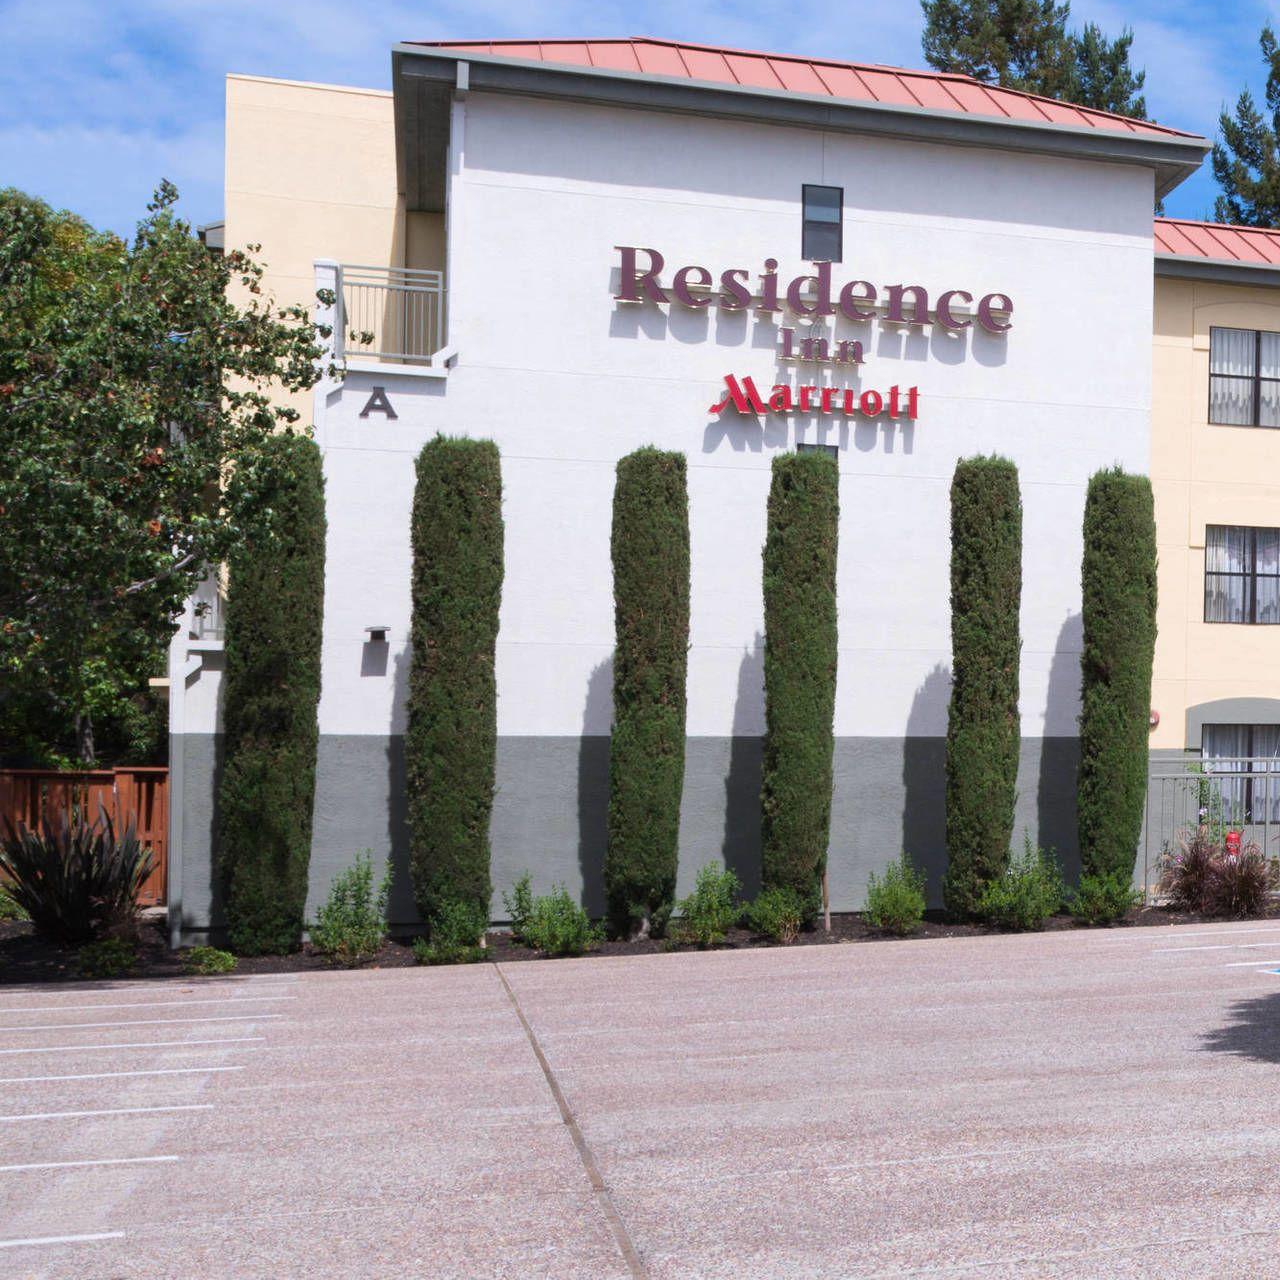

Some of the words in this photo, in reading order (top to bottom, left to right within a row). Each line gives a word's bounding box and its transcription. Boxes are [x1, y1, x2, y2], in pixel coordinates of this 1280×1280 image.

[613, 246, 1014, 333] Residence
[778, 327, 866, 366] Inn
[360, 387, 398, 418] A
[708, 373, 921, 420] Marriott
